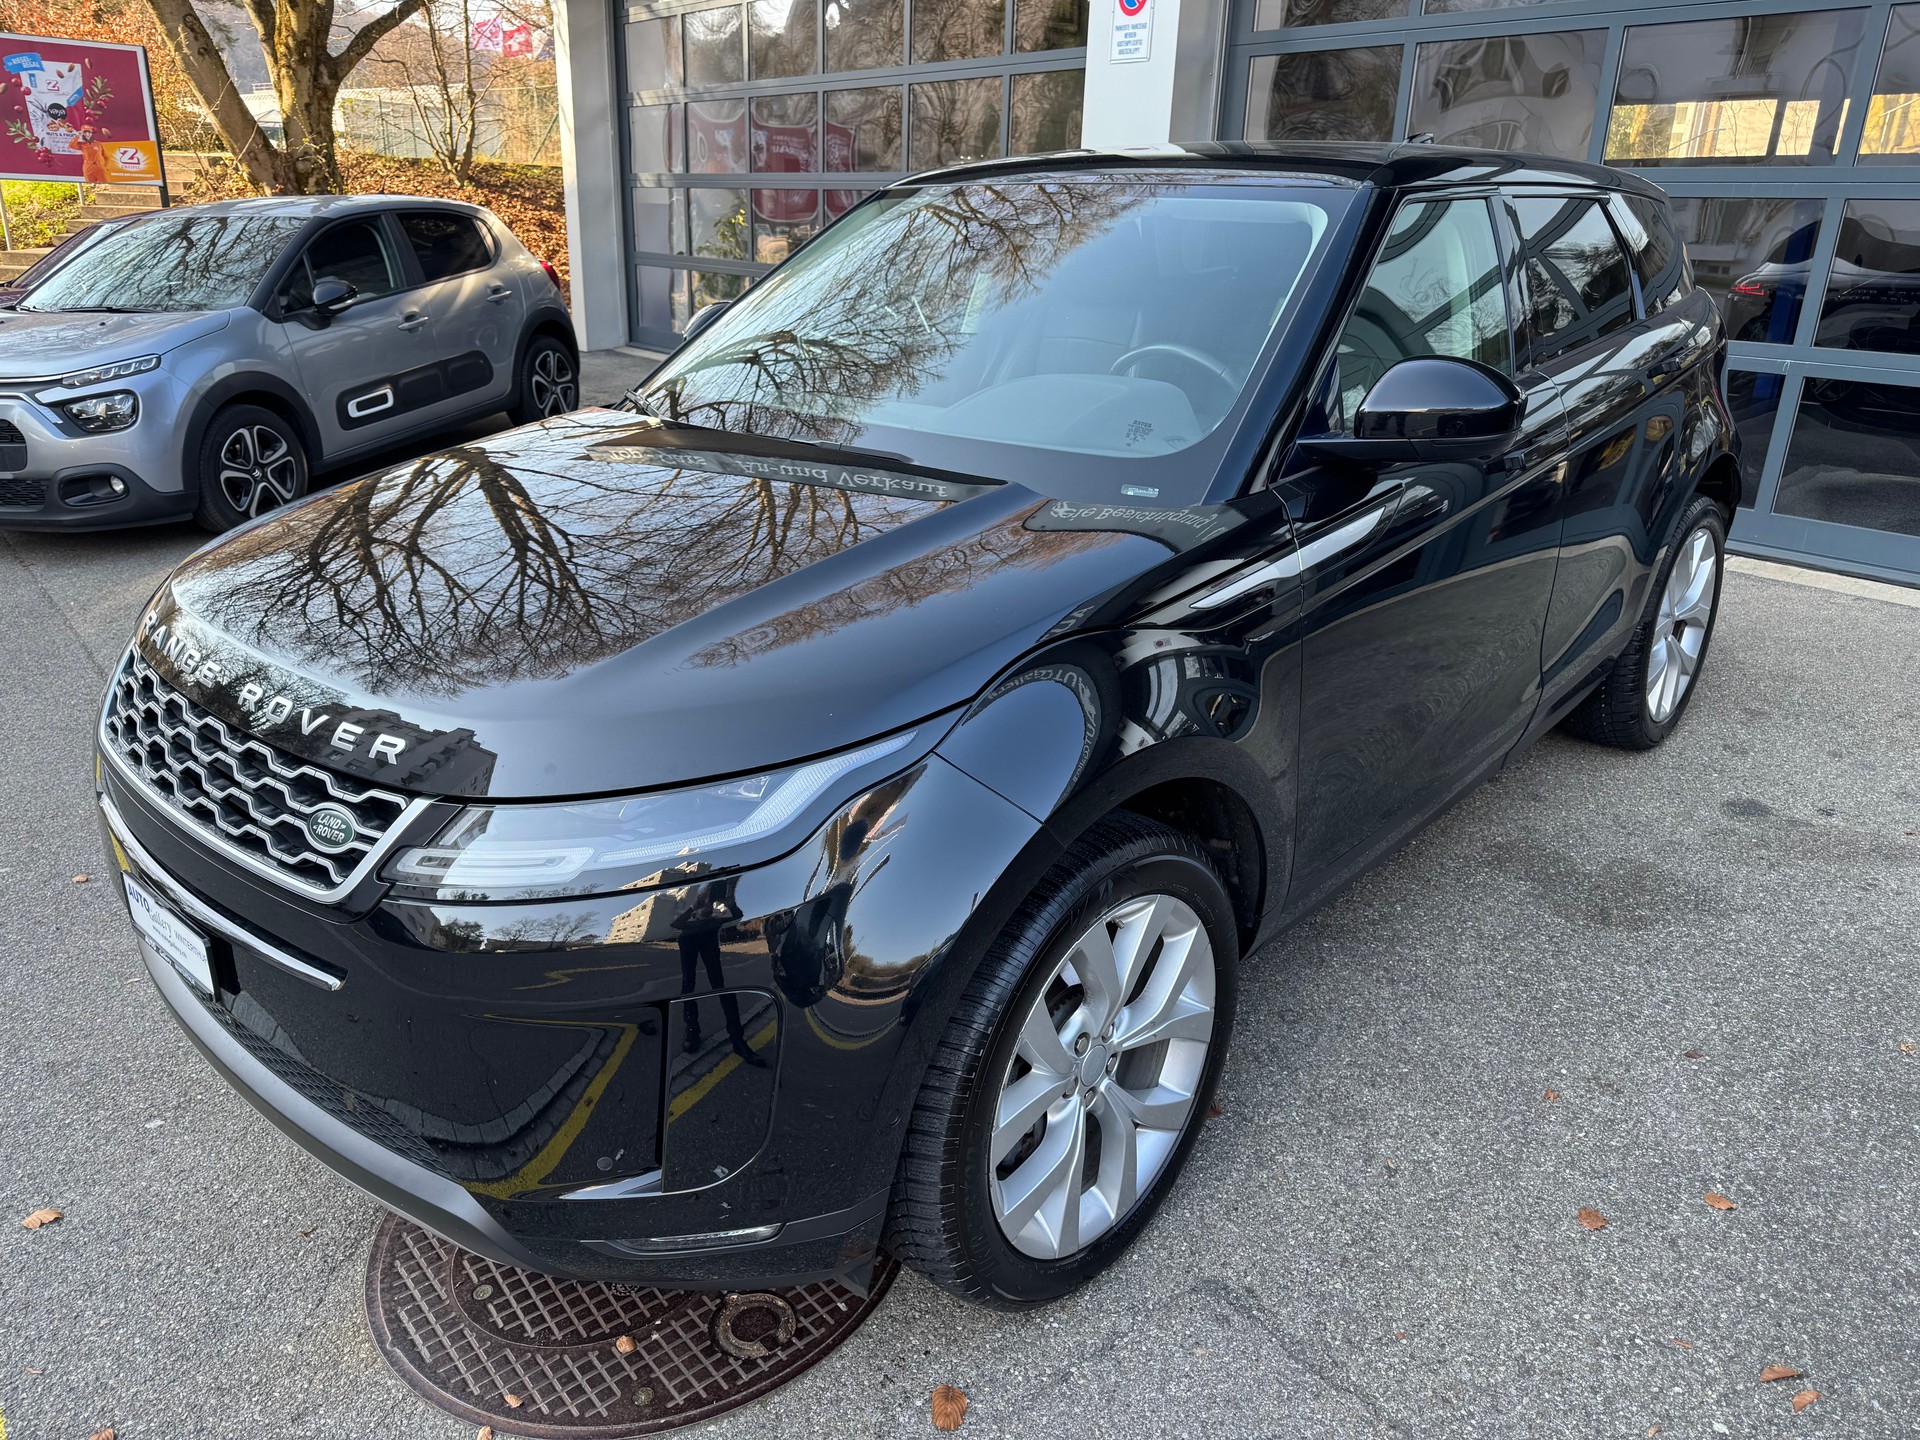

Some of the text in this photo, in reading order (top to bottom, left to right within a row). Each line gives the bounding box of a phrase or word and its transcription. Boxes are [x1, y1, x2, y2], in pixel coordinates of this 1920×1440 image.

[118, 147, 140, 165] Z
[142, 610, 408, 765] RANGE ROVER
[317, 813, 342, 830] LAND
[315, 824, 345, 843] ROVER
[128, 883, 151, 913] AUTO
